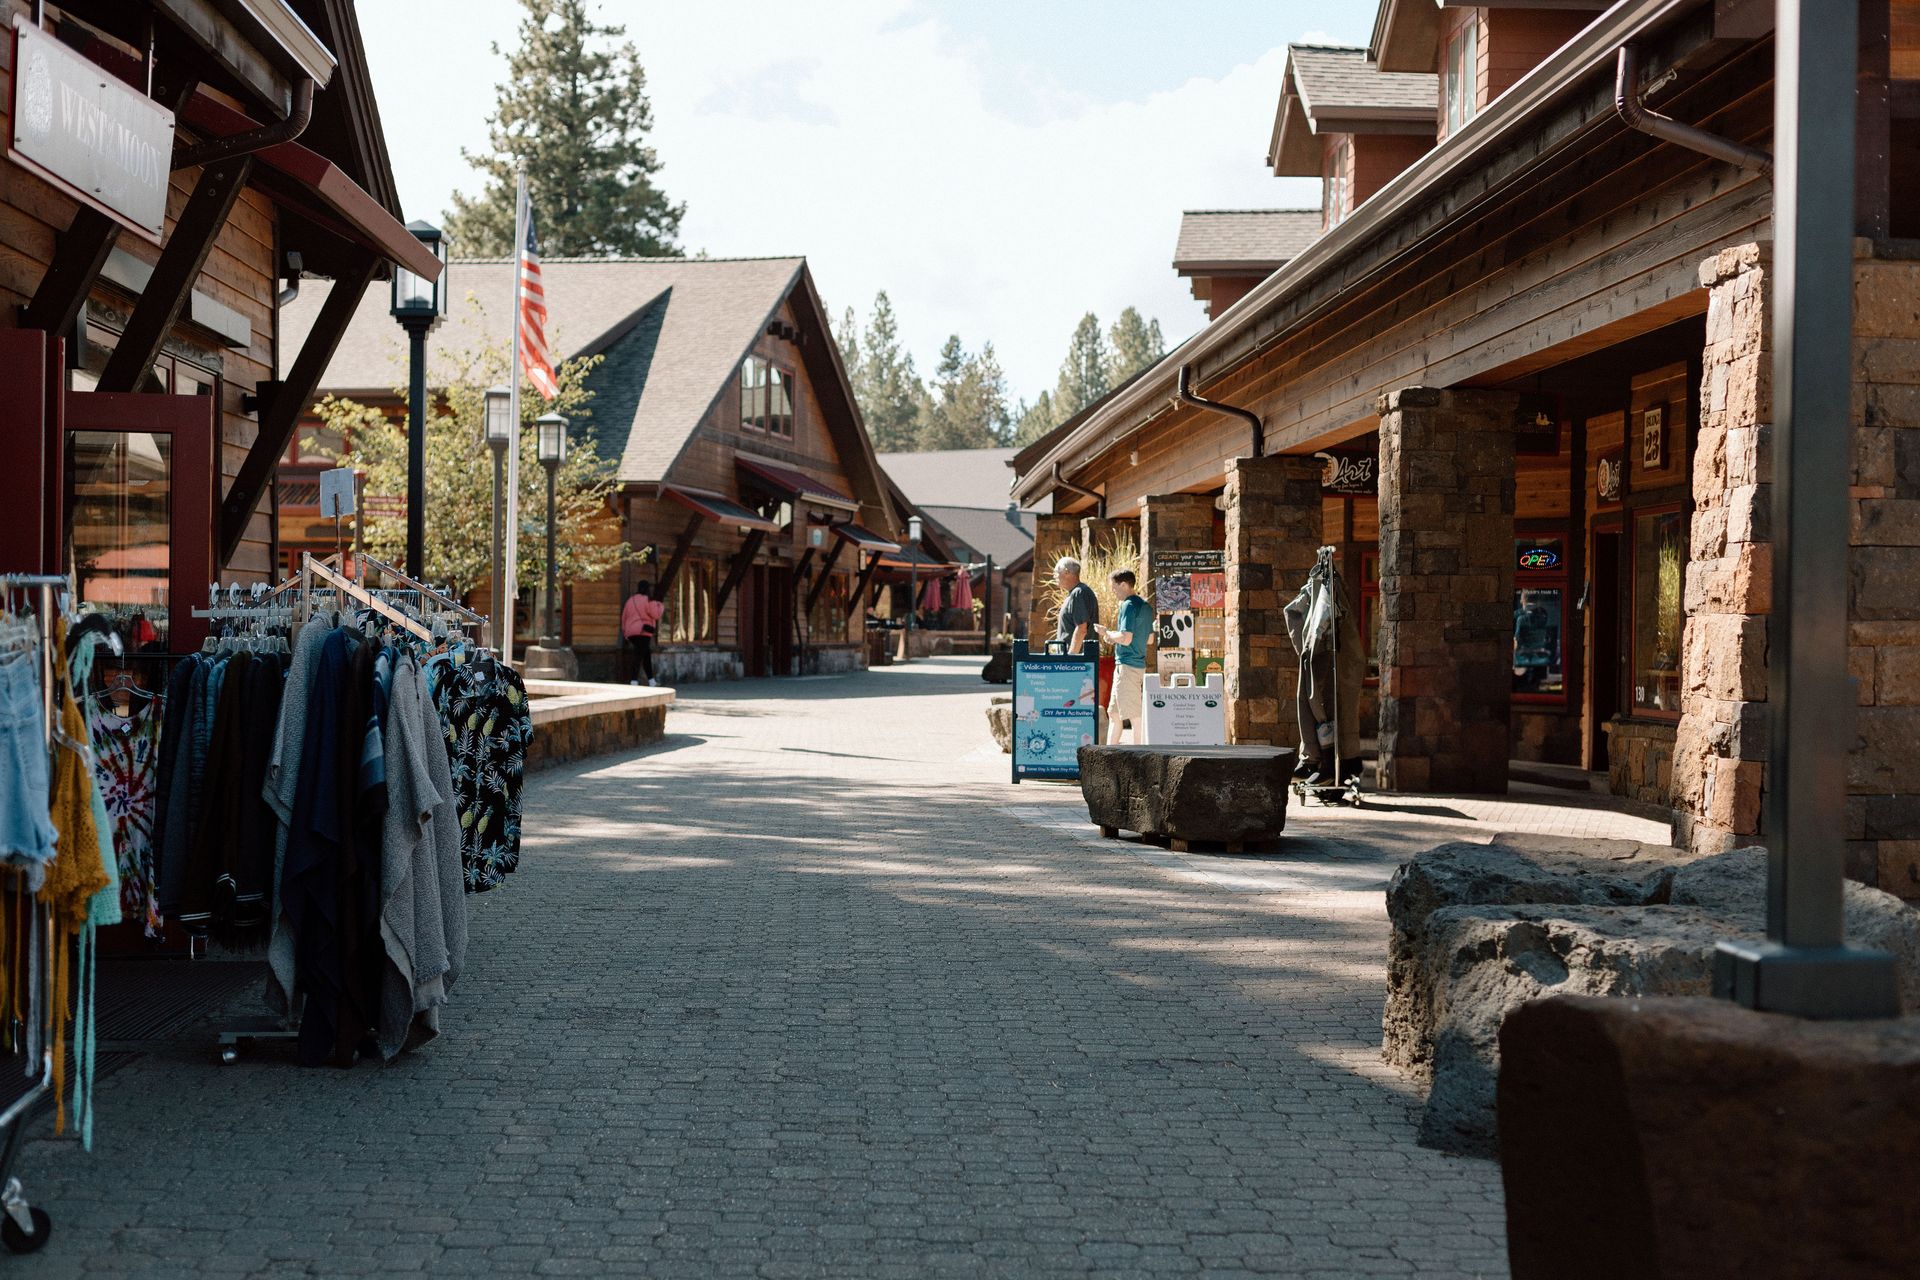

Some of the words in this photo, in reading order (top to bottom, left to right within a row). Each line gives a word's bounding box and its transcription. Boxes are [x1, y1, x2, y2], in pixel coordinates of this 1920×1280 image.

[60, 79, 107, 154] WEST
[116, 123, 161, 192] MOON
[1645, 430, 1660, 461] 23
[1520, 554, 1556, 566] OPEN
[1024, 663, 1052, 671] Walk-ins
[1054, 663, 1086, 671] Welcome
[1202, 692, 1221, 700] SHOP
[1635, 686, 1645, 702] 130
